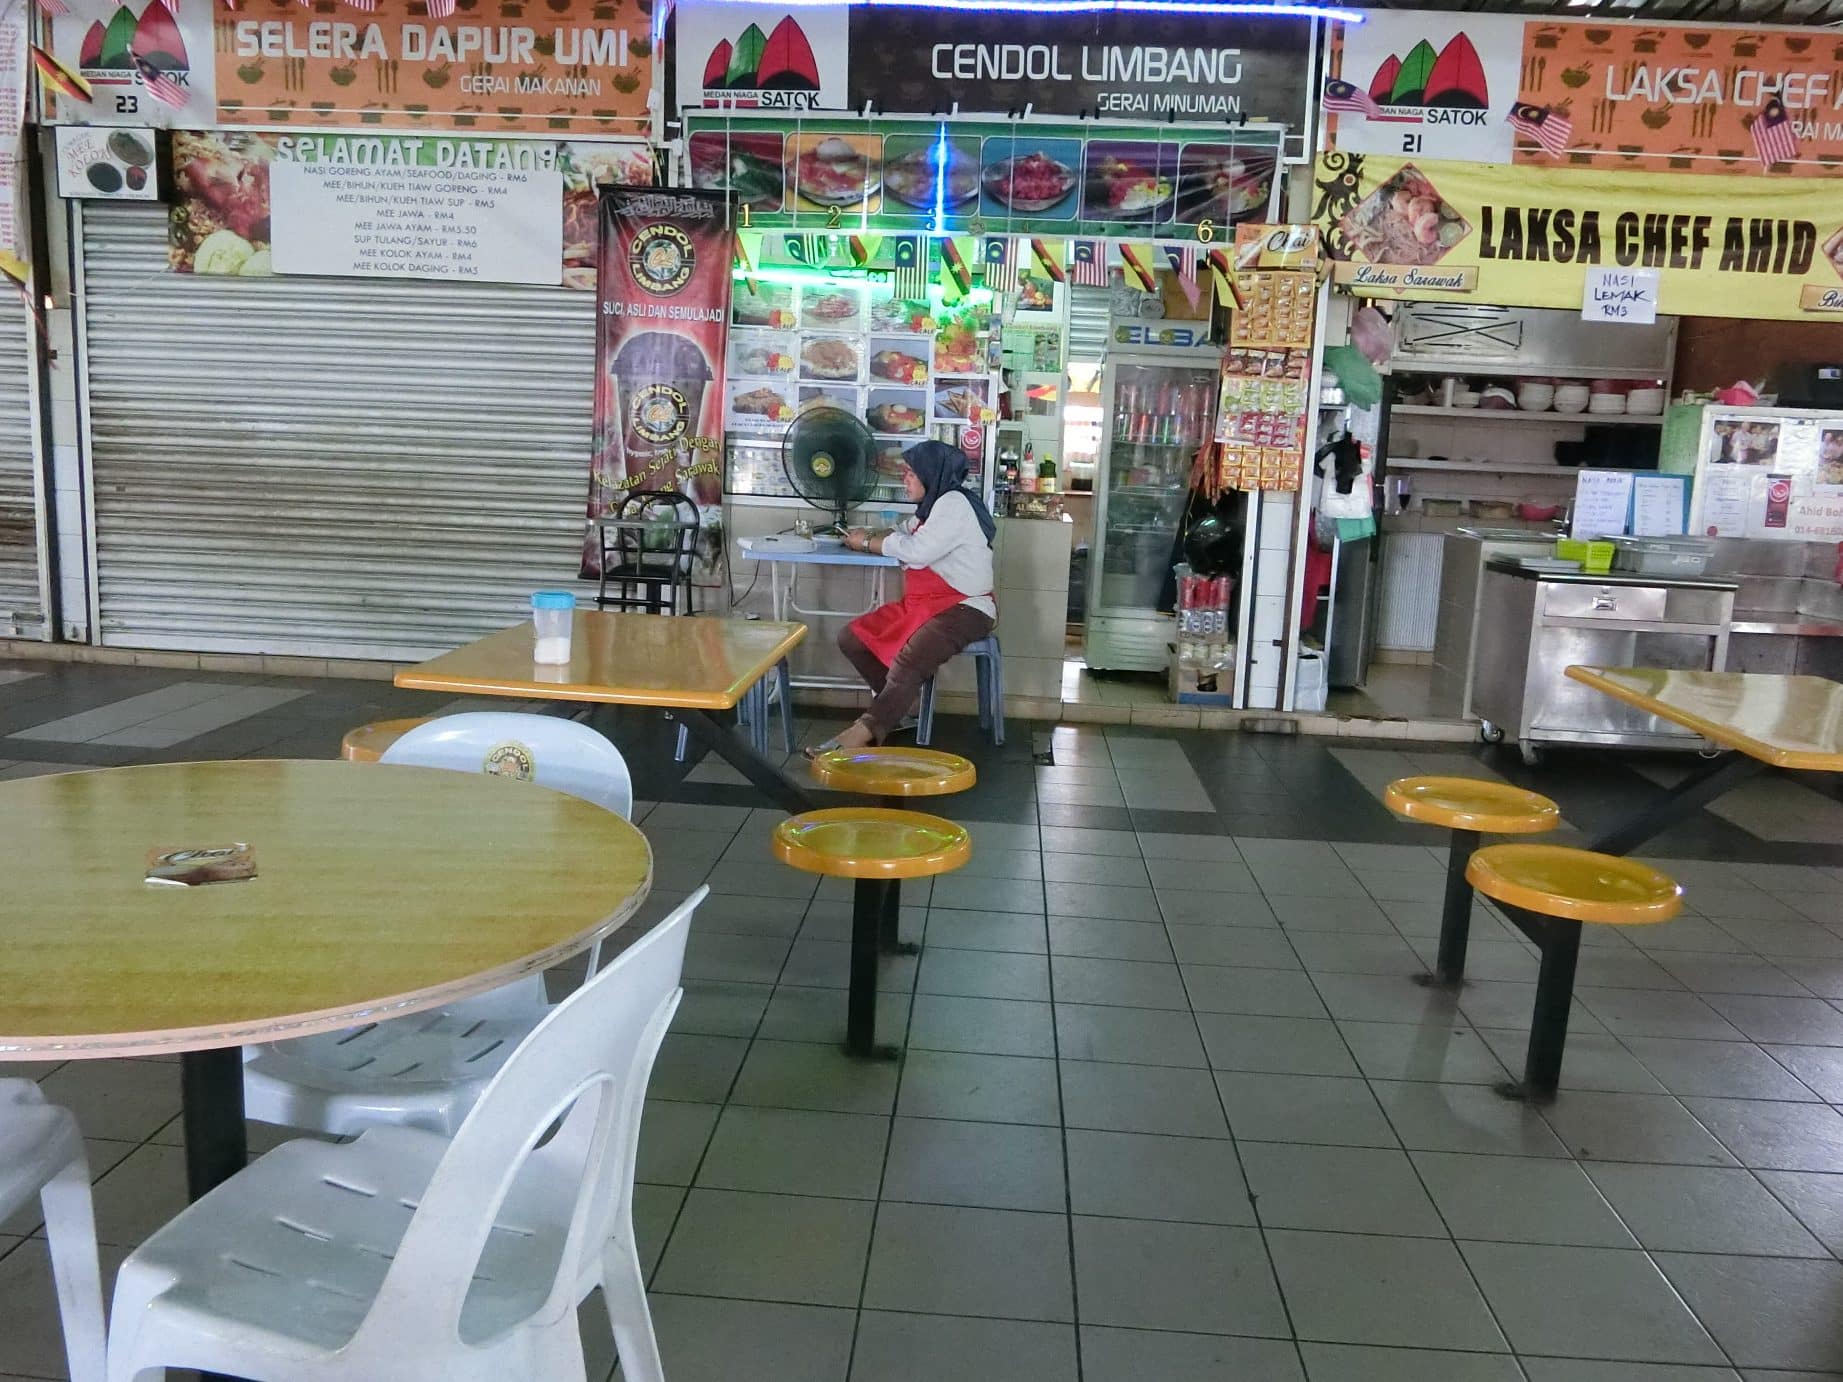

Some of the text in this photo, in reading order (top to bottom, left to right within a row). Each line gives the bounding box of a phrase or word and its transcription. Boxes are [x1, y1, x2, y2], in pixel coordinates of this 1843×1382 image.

[236, 20, 628, 67] SELERA DAPUR UMI
[932, 44, 1242, 84] CENDOL LIMBANG
[460, 75, 601, 96] GERAI MAKANAN
[1606, 65, 1723, 104] LAKSA
[1733, 70, 1830, 109] CHEF
[733, 91, 759, 99] NIAGA
[761, 92, 820, 107] SATOK
[1098, 92, 1240, 114] GERAI MINUMAN
[116, 96, 138, 113] 23
[1398, 107, 1424, 116] NIAGA
[1427, 109, 1488, 126] SATOK
[1402, 133, 1422, 152] 21
[304, 166, 528, 182] NASI GORENG AYAM/SEAFOOD/DAGING RM6
[323, 180, 508, 195] MEE/BIHUN/KUEH TIAW GORENG RM4
[336, 194, 417, 205] MEE/BIHUN/KUEH
[420, 197, 444, 206] TIAW
[447, 198, 465, 207] SUP
[376, 209, 454, 220] MEE JAWA RM4
[826, 205, 842, 229] 2
[354, 222, 373, 231] MEE
[376, 223, 402, 231] JAWA
[405, 224, 432, 232] AYAM
[1197, 219, 1213, 243] 6
[354, 235, 371, 244] SUP
[376, 235, 447, 247] TULANG/SAYUR
[632, 225, 693, 258] CENDOL
[1478, 206, 1817, 275] LAKSA CHEF AHID
[360, 248, 377, 257] MEE
[381, 249, 411, 258] KOLOK
[415, 251, 442, 260] AYAM
[353, 262, 371, 271] MEE
[374, 262, 405, 272] KOLOK
[409, 263, 449, 274] DAGING
[632, 264, 690, 291] LIMBANG
[1354, 266, 1464, 288] Laksa Sarawak
[1603, 272, 1635, 288] NASI
[1594, 287, 1652, 303] LEMAK
[627, 303, 647, 317] ASLI
[648, 304, 667, 318] DAN
[668, 306, 725, 322] SEMULAJADI
[1602, 304, 1629, 317] RM3
[632, 385, 687, 414] CENDOL
[632, 417, 685, 441] LIMBANG
